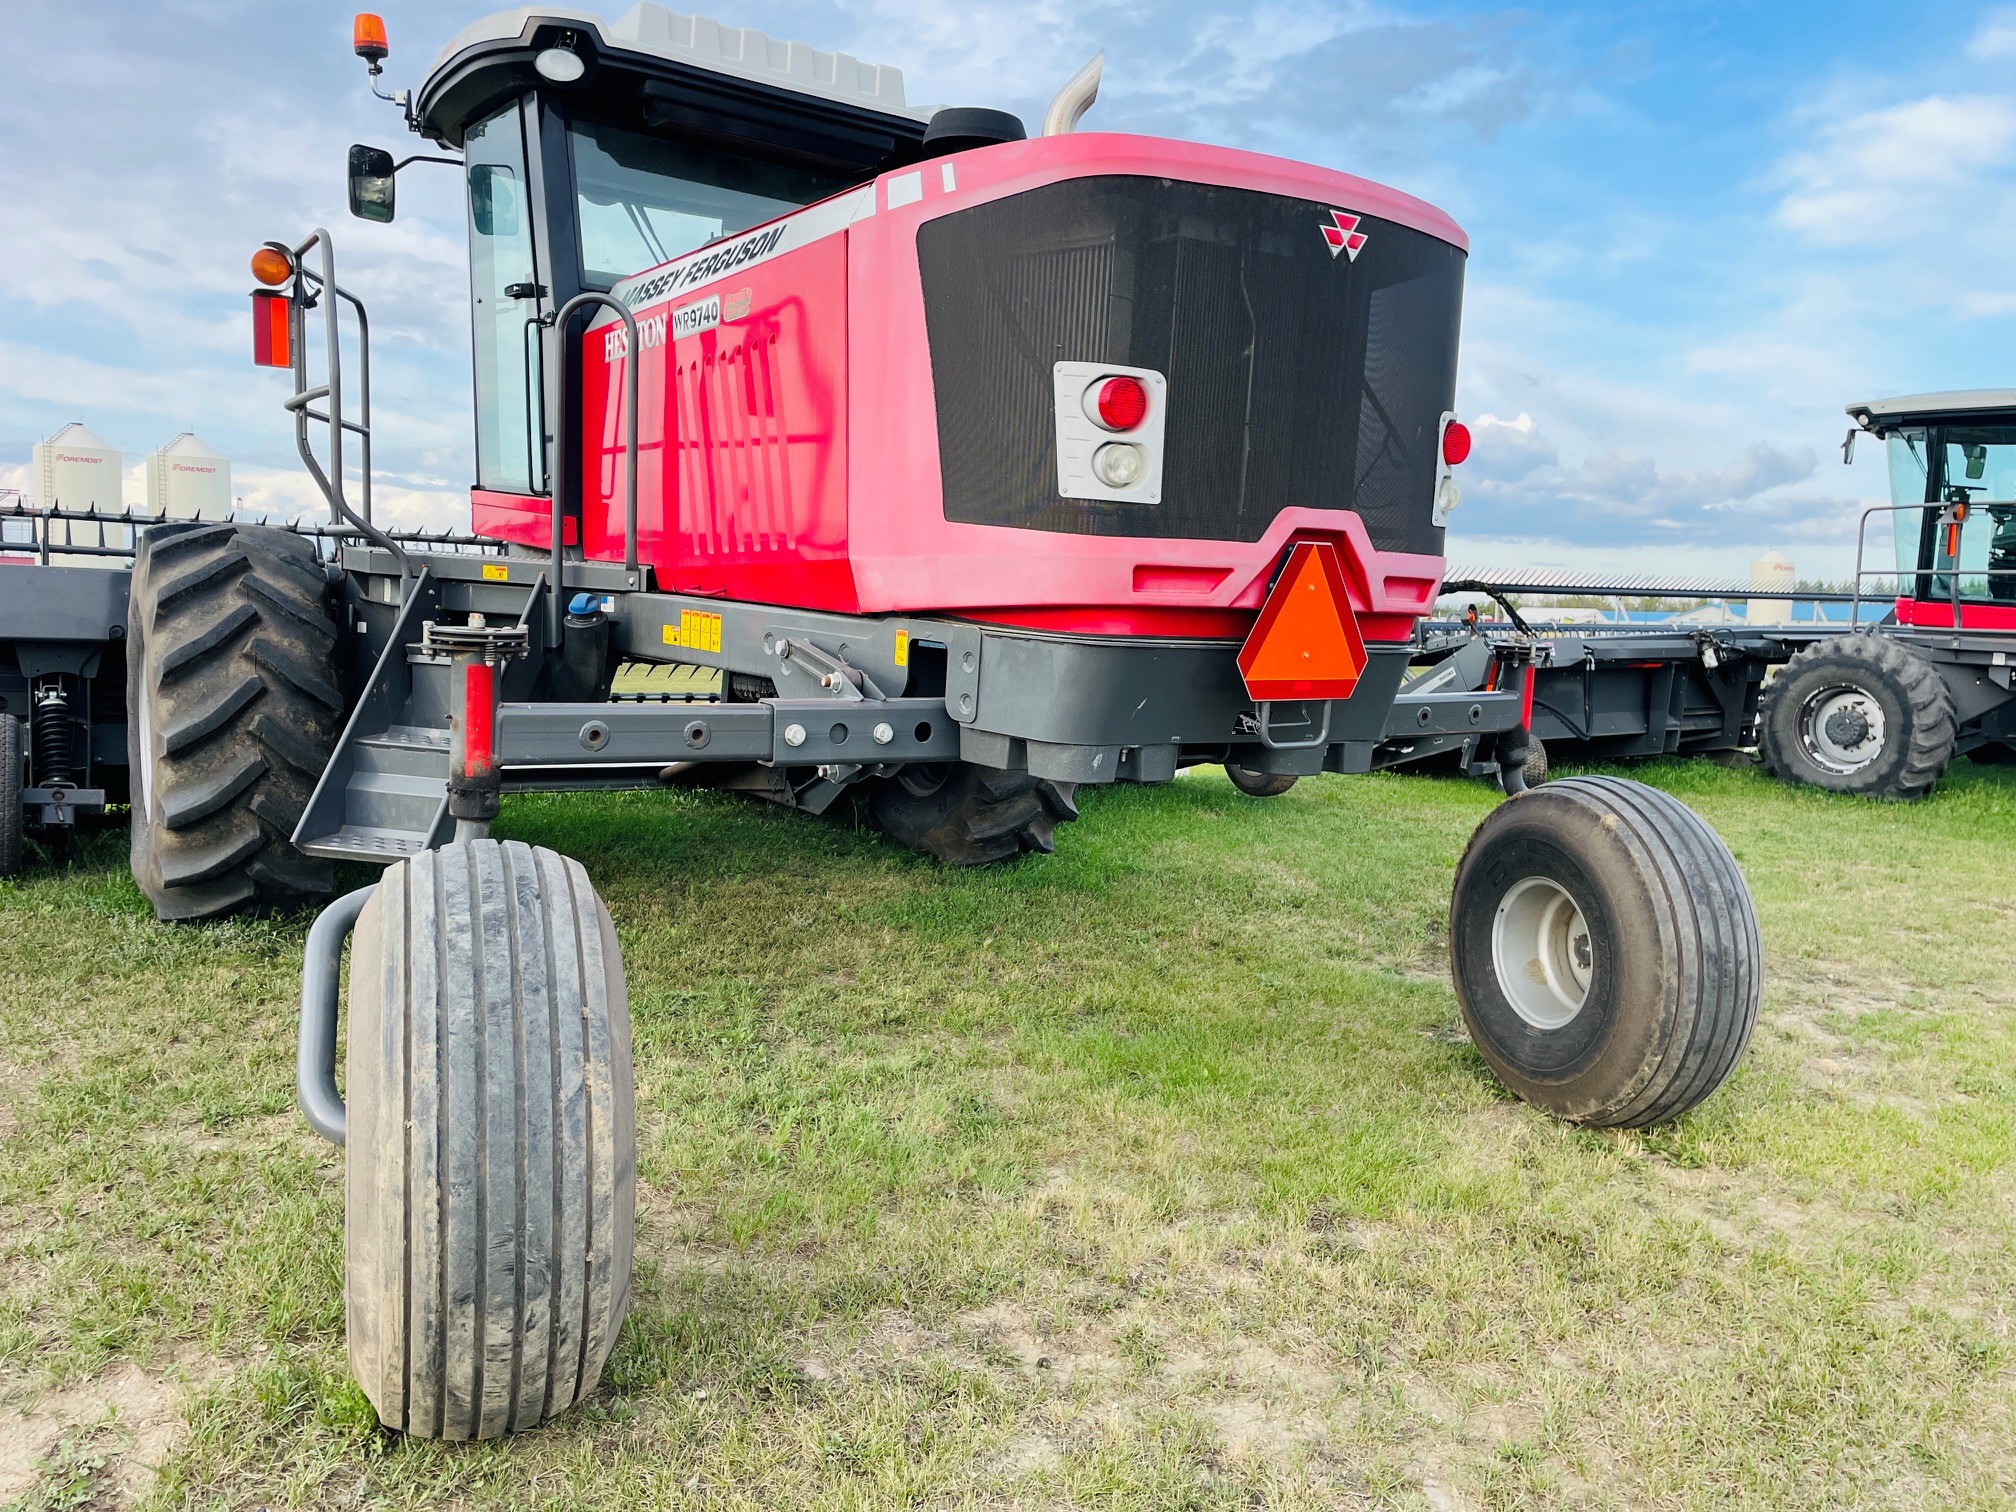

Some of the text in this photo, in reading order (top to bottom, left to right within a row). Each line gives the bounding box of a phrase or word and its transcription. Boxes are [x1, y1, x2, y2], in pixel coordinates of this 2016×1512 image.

[621, 266, 686, 308] MASSEY
[679, 224, 787, 288] FERGUSON
[673, 301, 718, 333] WR9740
[604, 312, 667, 363] HESTON
[56, 453, 103, 464] FOREMOST
[172, 463, 217, 474] FOREMOST
